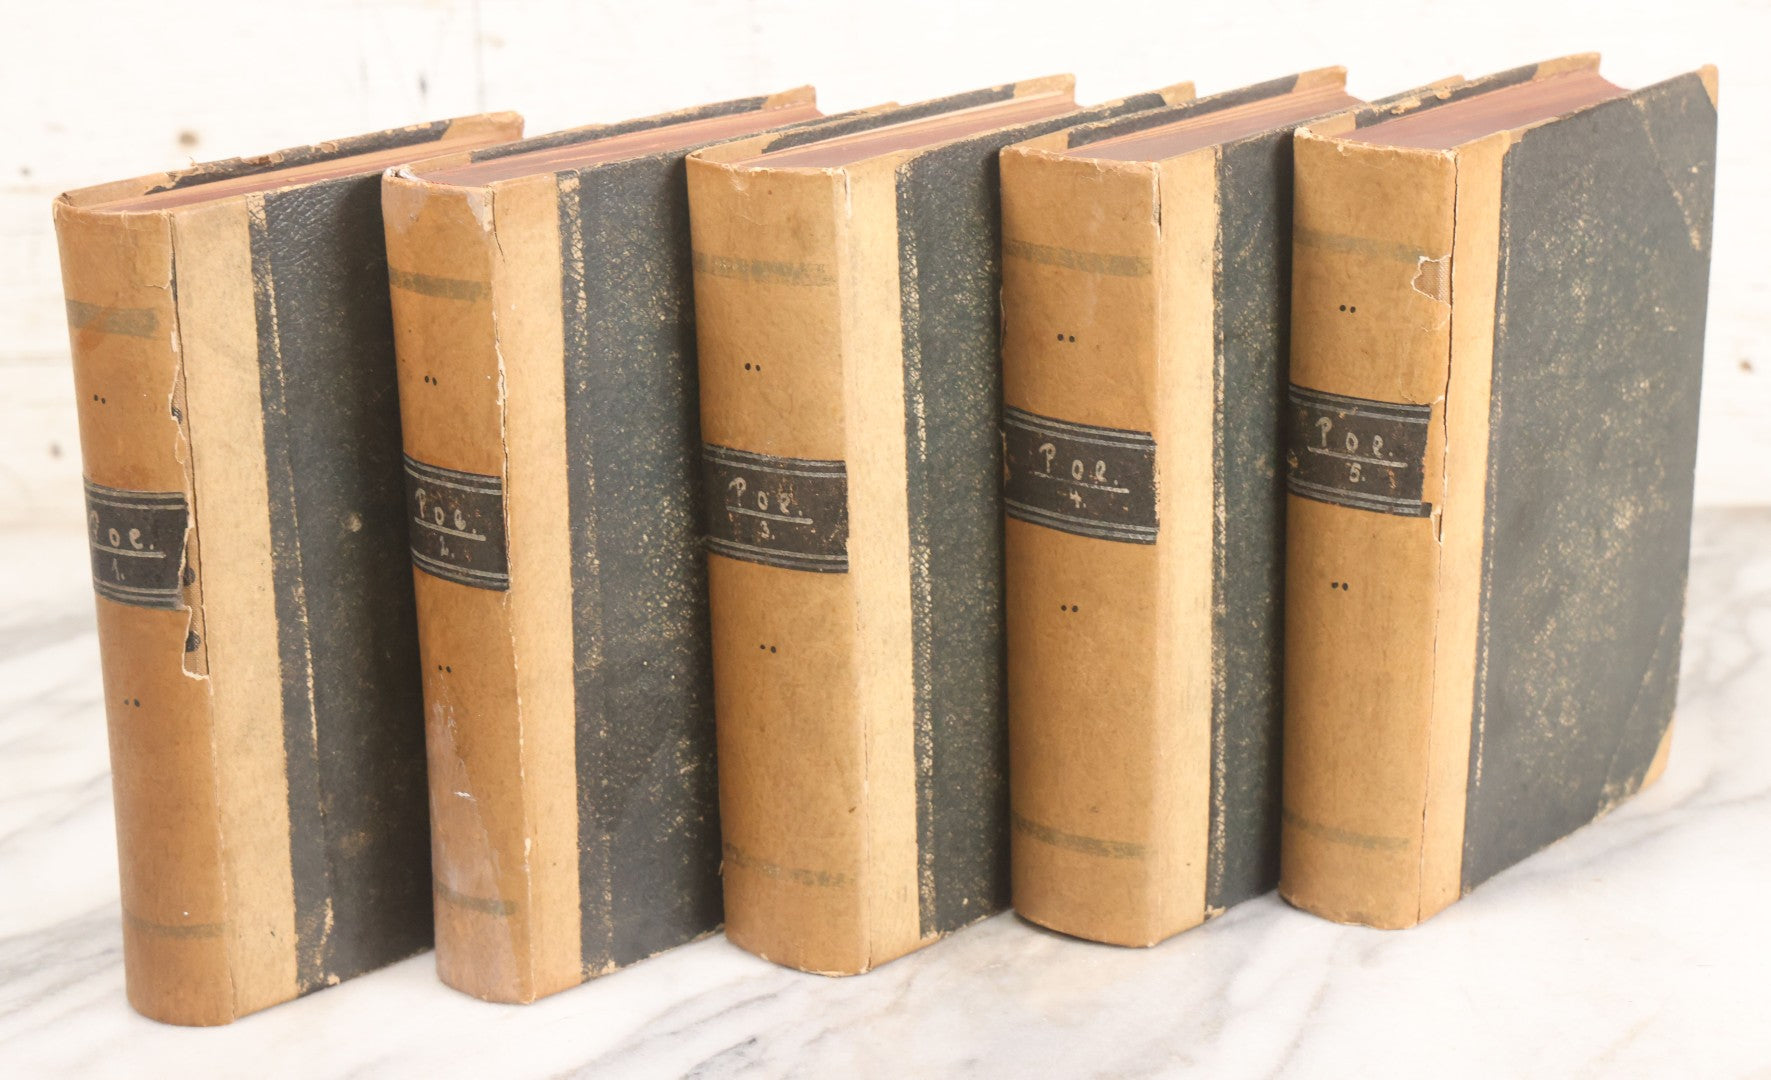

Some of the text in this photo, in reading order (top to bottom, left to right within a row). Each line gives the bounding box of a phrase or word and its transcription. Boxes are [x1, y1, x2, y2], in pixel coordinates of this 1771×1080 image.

[1315, 416, 1393, 459] Poe.
[1038, 442, 1118, 486] Poe.
[414, 488, 477, 534] Poe.
[728, 477, 803, 517] Poe.
